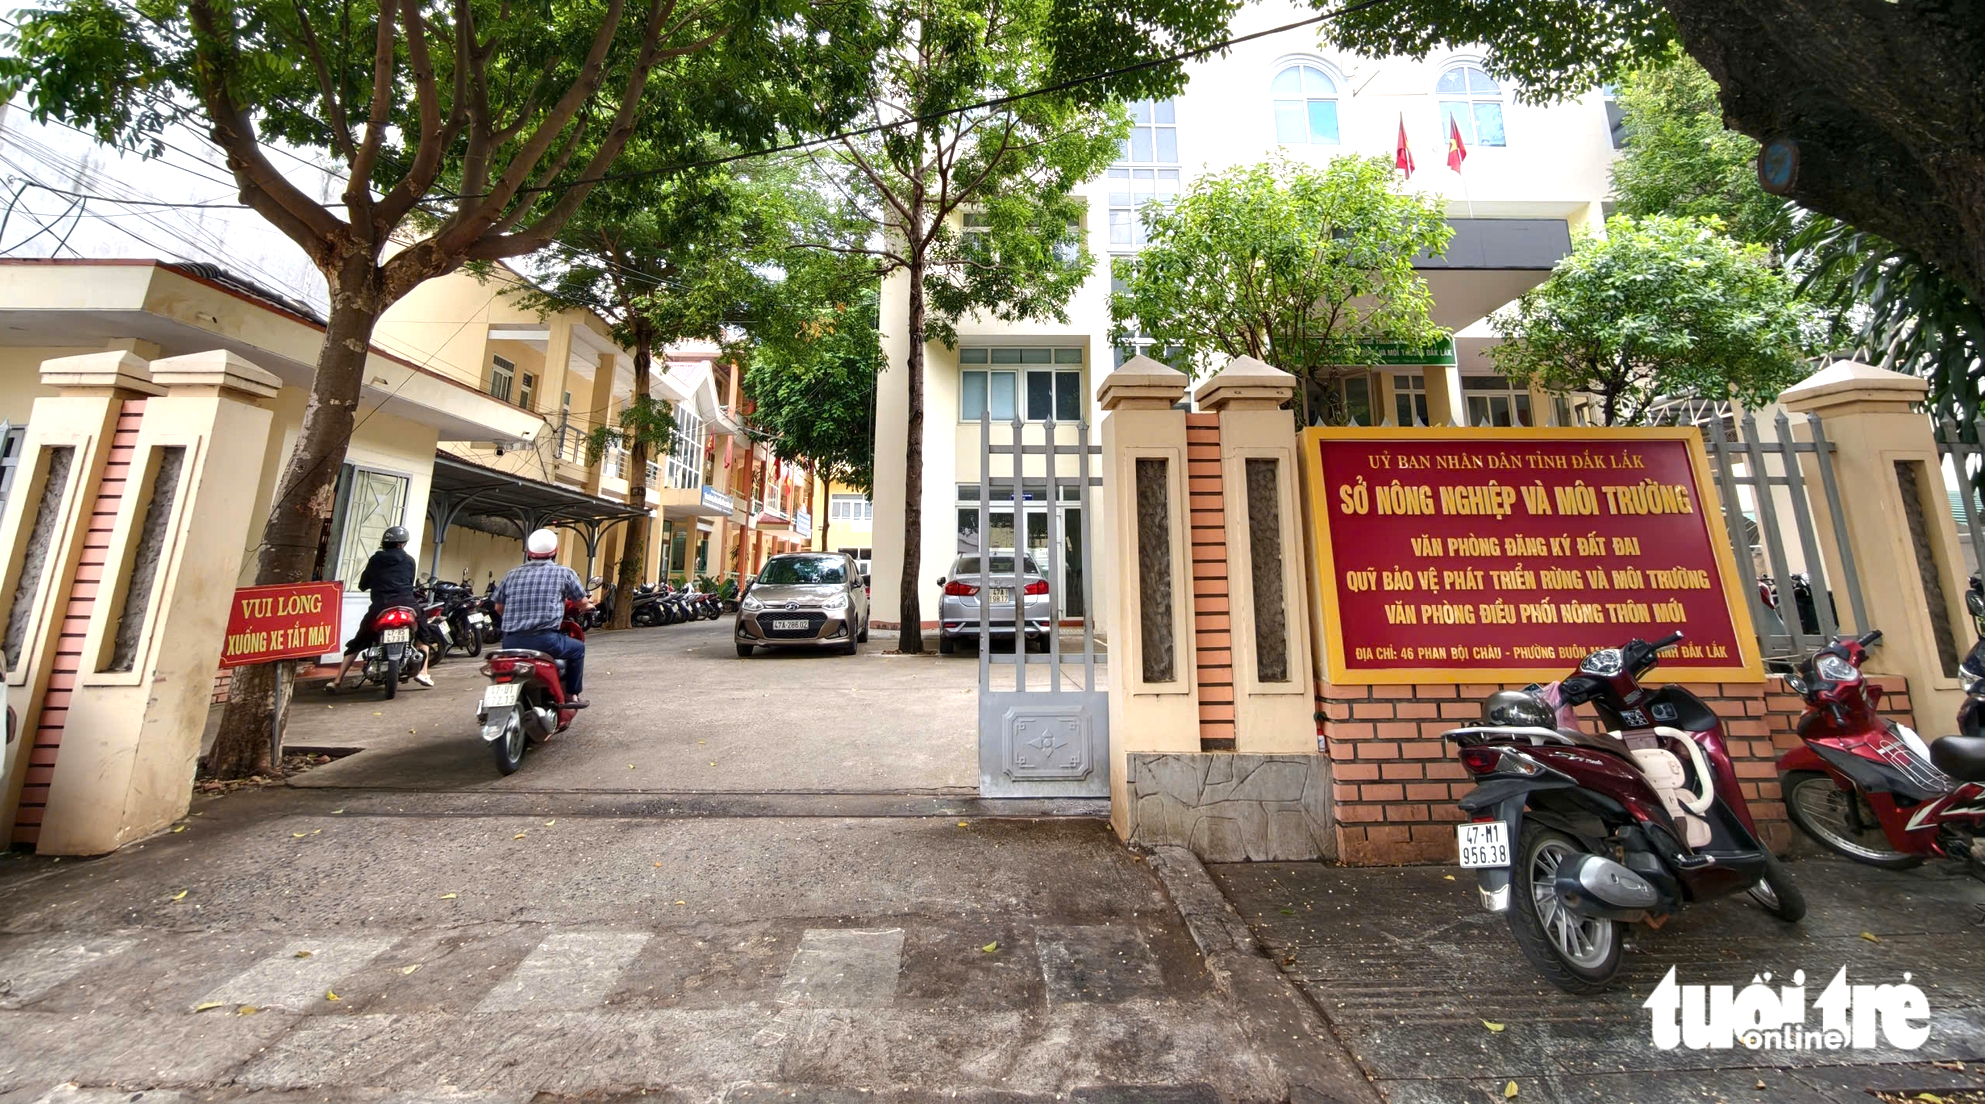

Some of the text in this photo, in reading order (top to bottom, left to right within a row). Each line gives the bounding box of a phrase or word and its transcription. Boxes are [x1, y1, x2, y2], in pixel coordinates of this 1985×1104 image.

[1368, 449, 1645, 469] UỶ BAN NHÂN DÂN TỈNH ĐẮK LẮK
[1339, 475, 1693, 520] SỞ NÔNG NGHIỆP VÀ MÔI TRƯỜNG
[1411, 531, 1641, 557] VĂN PHÒNG ĐĂNG KÝ ĐẤT ĐAI
[1346, 562, 1711, 594] QUỸ BẢO VỆ PHÁT TRIỂN RỪNG VÀ MÔI TRƯỜNG
[241, 590, 323, 619] VUI LÒNG
[1385, 597, 1687, 624] VĂN PHÒNG ĐIỀU PHỐI NÔNG THÔN MỚI
[227, 621, 331, 656] XUỐNG XE TẮT MÁY
[1355, 647, 1373, 662] ĐỊA
[1376, 644, 1397, 660] CHỈ:
[1401, 647, 1414, 660] 46
[1418, 647, 1447, 660] PHAN
[1451, 644, 1469, 662] BỘI
[1473, 645, 1502, 660] CHÂU
[1514, 643, 1556, 659] PHƯỜNG
[1558, 644, 1588, 659] BUÔN
[1681, 641, 1704, 658] ĐẮK
[1706, 641, 1728, 658] LẮK
[1466, 824, 1499, 844] 47-M1
[1463, 845, 1506, 865] 956.38
